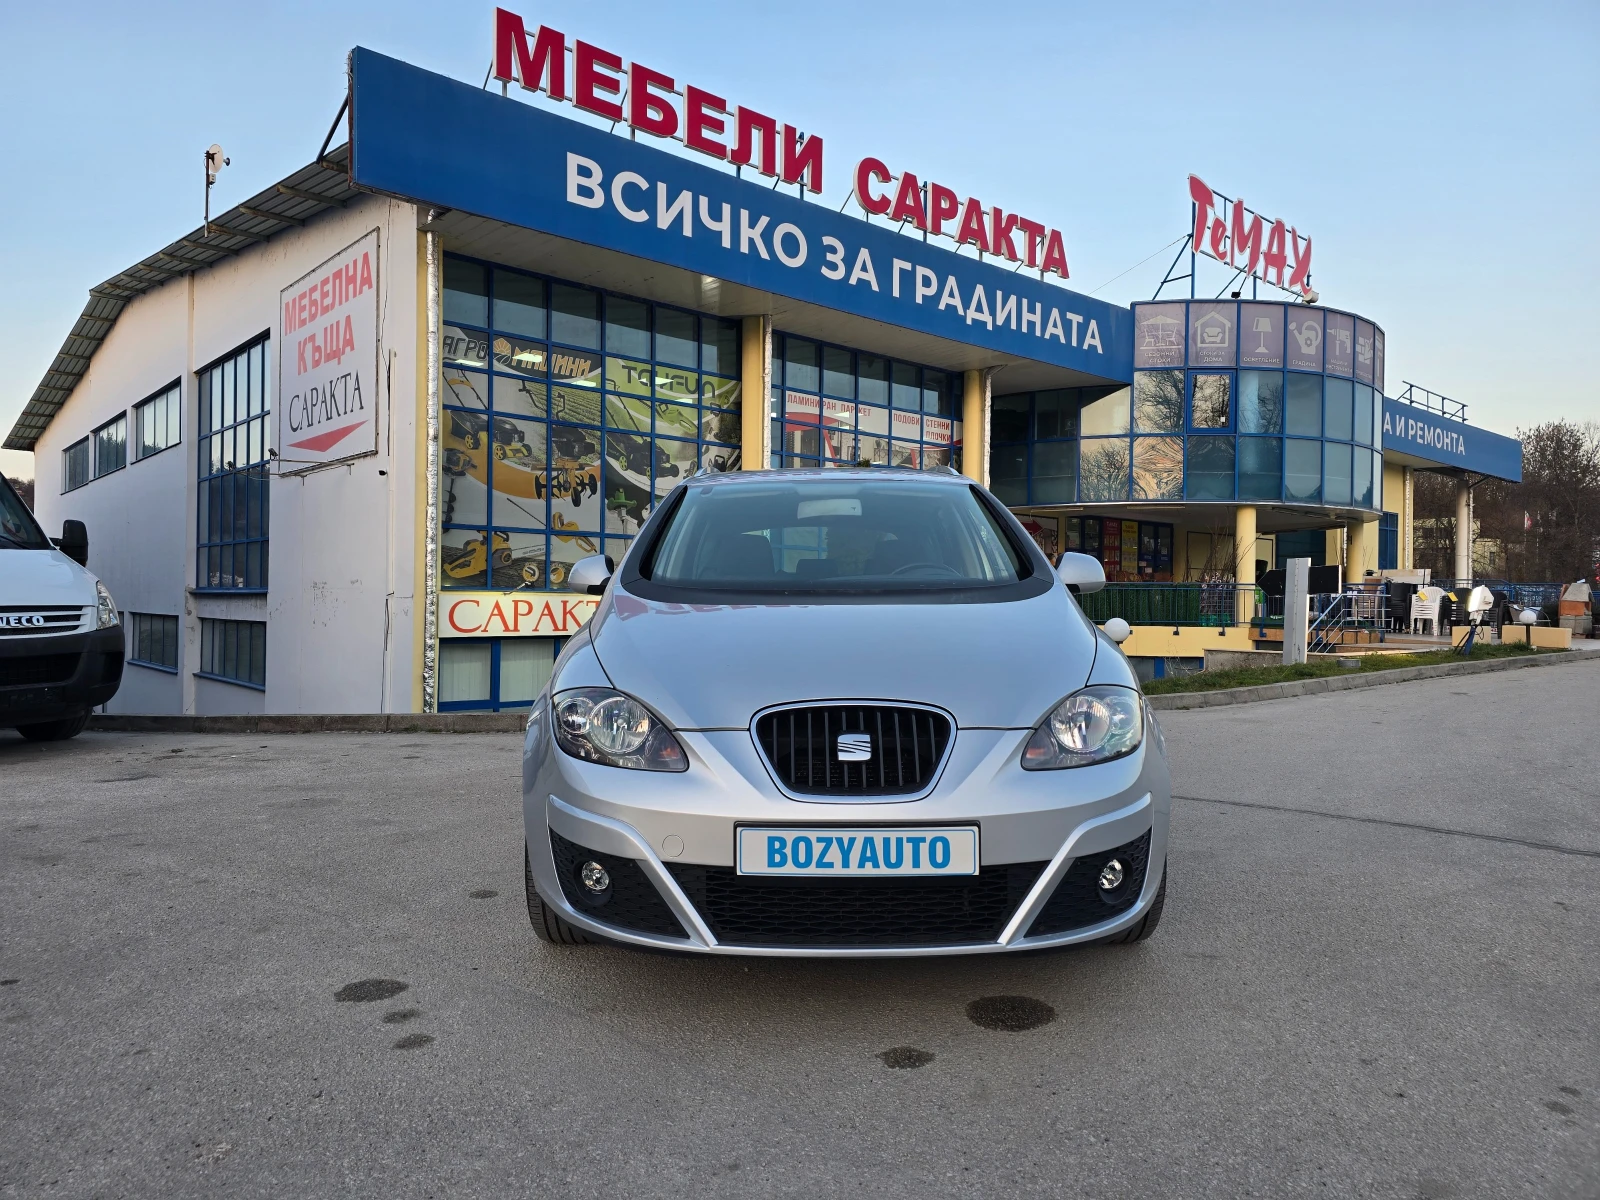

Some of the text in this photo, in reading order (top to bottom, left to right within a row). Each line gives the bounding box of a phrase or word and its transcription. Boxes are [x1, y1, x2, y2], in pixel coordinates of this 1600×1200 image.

[492, 6, 1070, 279] МЕБЕЛИ САРАКТА
[567, 151, 1103, 354] ВСИЧКО ЗА ГРАДИНАТА
[284, 251, 373, 337] МЕБЕЛНА
[297, 314, 355, 376] КЪЩА
[442, 335, 489, 360] АГРО
[289, 369, 364, 433] САРАКТА
[787, 393, 872, 417] ЛАМИНИРАН ПАРКЕТ
[893, 413, 950, 431] ПОДОВИ СТЕННИ
[925, 430, 951, 443] ПЛОЧКИ
[1396, 414, 1405, 438] И
[1408, 418, 1466, 456] РЕМОНТА
[767, 835, 951, 869] BOZYAUTO
